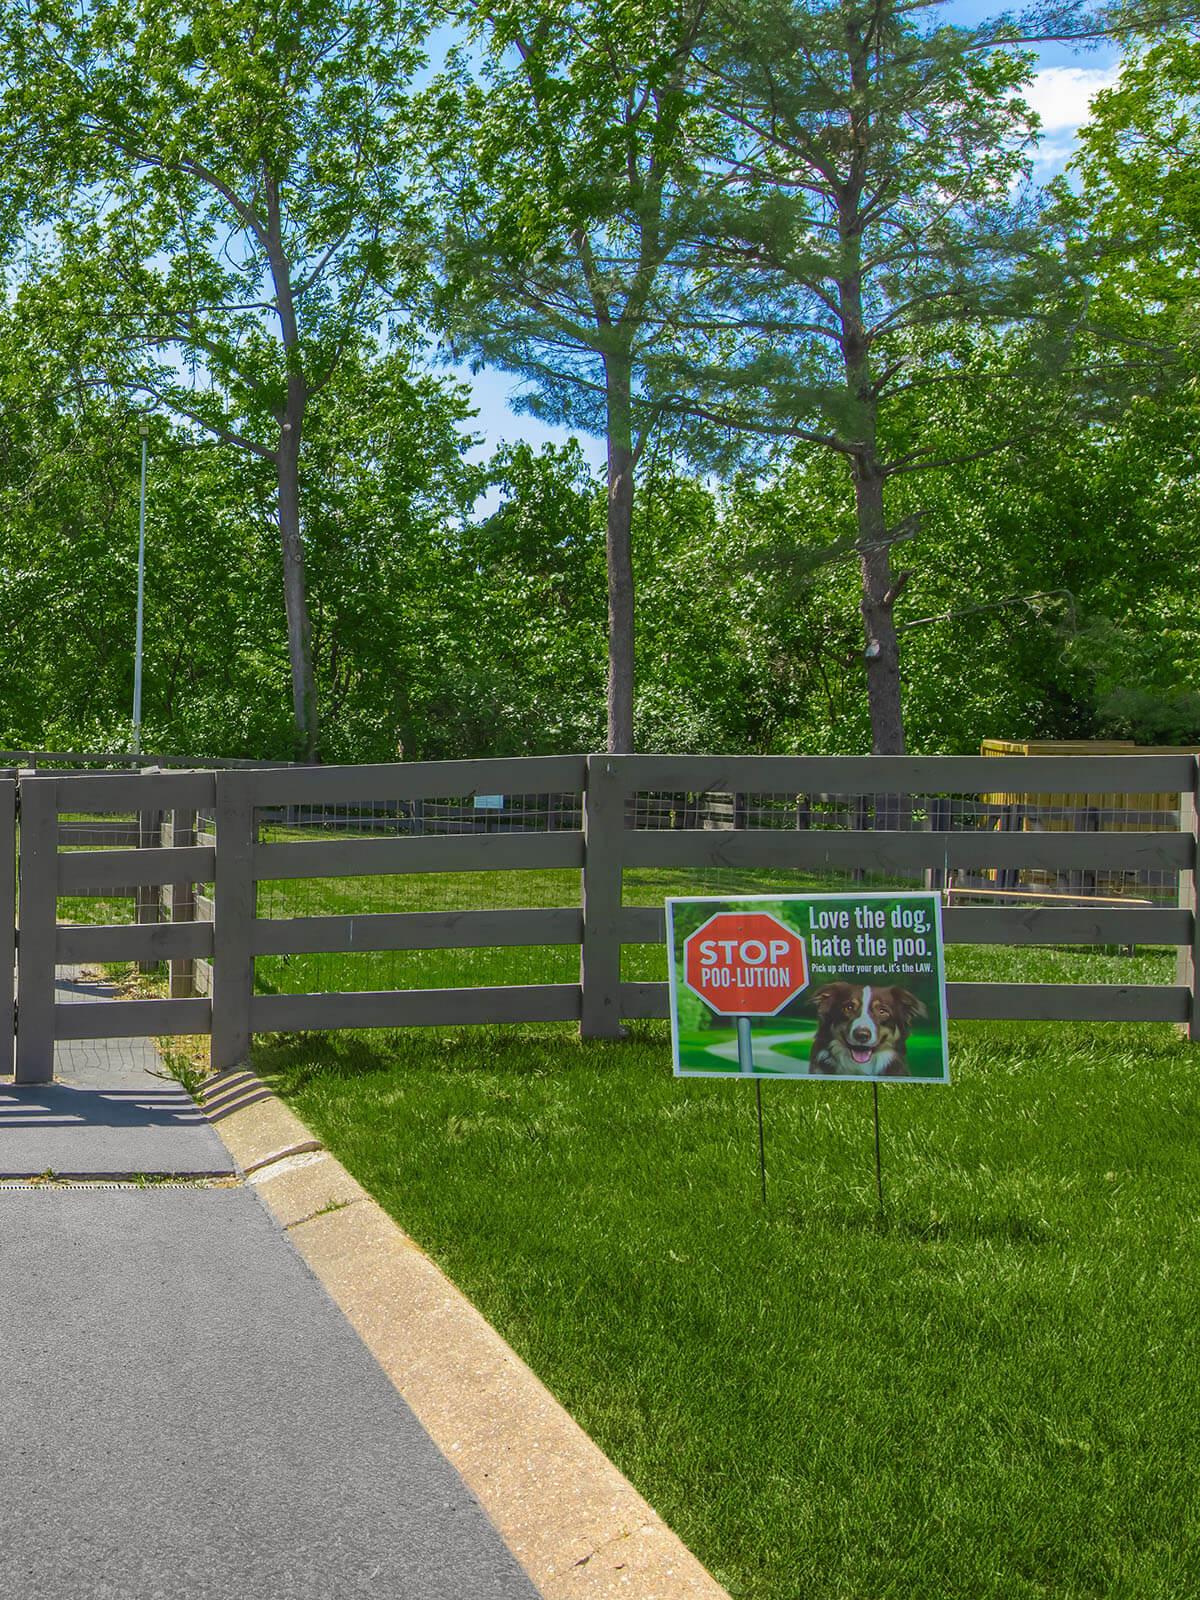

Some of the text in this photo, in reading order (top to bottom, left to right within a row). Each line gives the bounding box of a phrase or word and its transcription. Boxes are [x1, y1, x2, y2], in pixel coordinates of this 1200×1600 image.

[809, 904, 931, 934] Love the dog,
[700, 940, 790, 965] STOP
[811, 933, 932, 962] hate the poo.
[701, 967, 790, 987] POO-LUTION
[811, 963, 933, 974] Pick up after your pet, it's the LAW.
